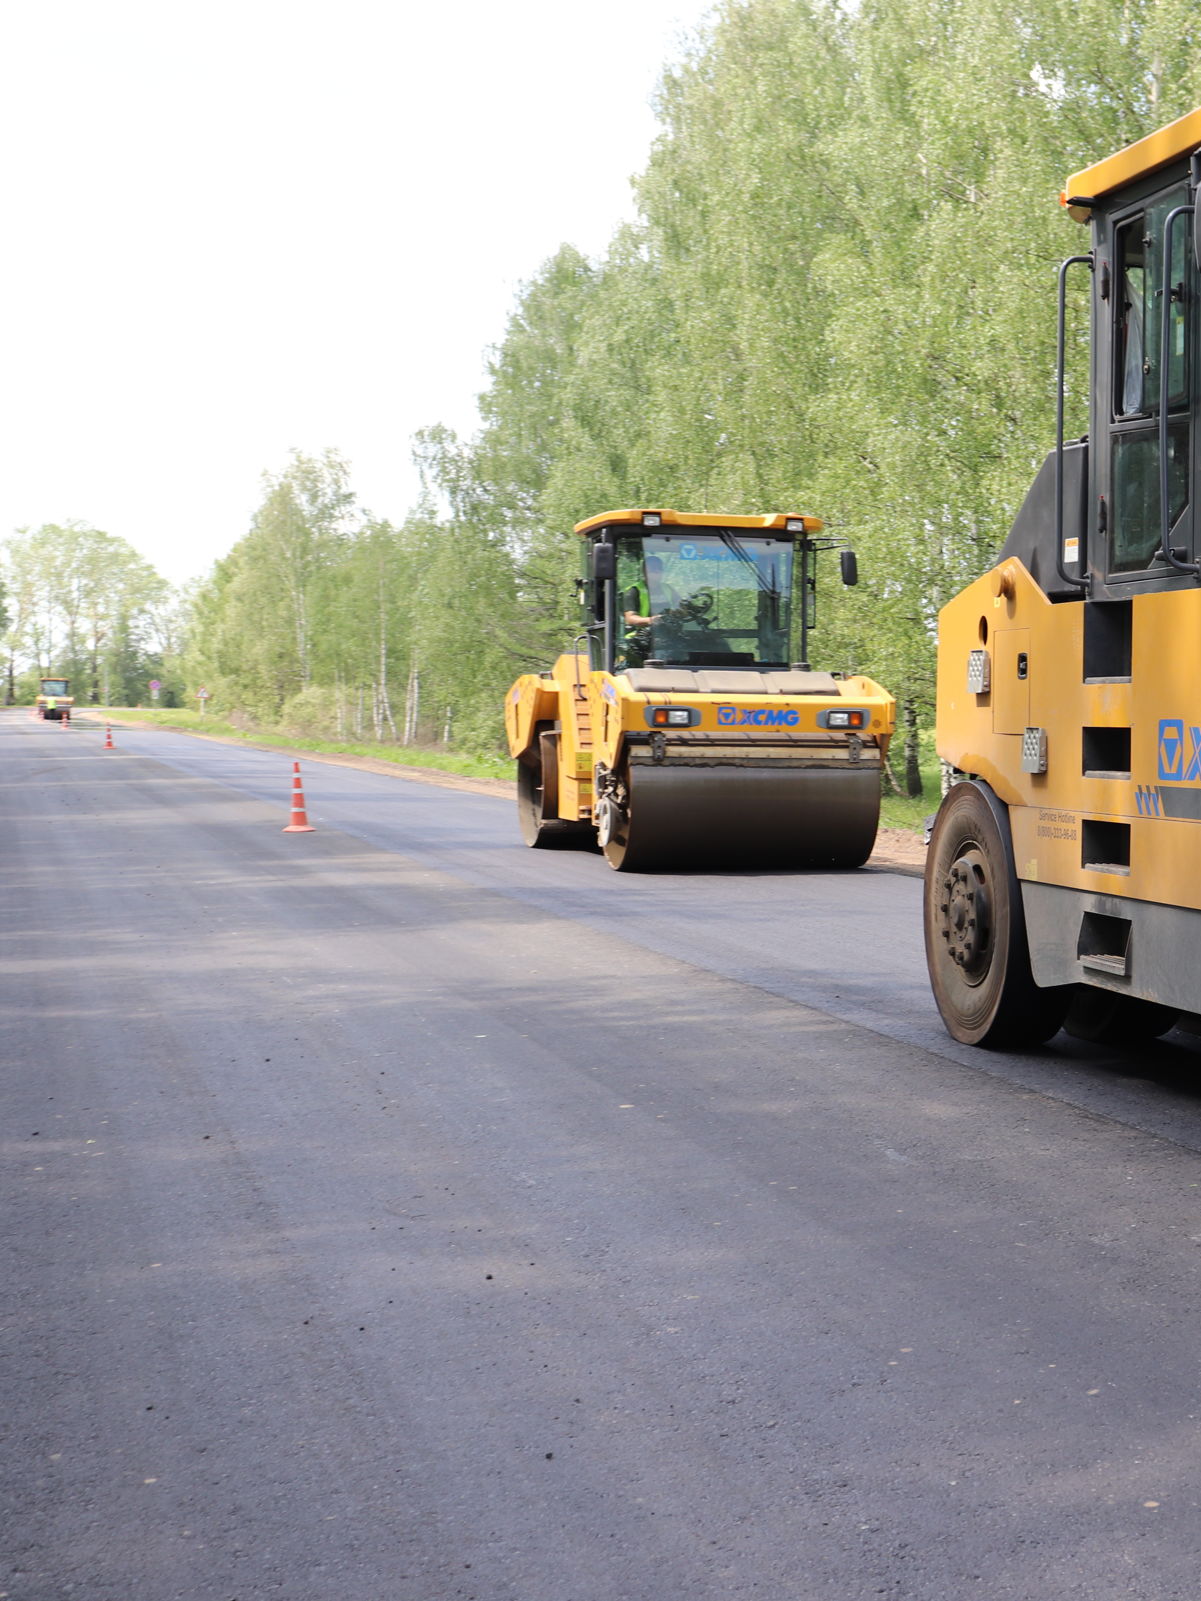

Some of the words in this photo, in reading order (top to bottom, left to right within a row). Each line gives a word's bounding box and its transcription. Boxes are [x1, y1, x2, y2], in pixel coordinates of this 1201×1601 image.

[736, 708, 800, 726] XCMG
[1038, 809, 1056, 822] Service
[1057, 812, 1076, 824] Hotline
